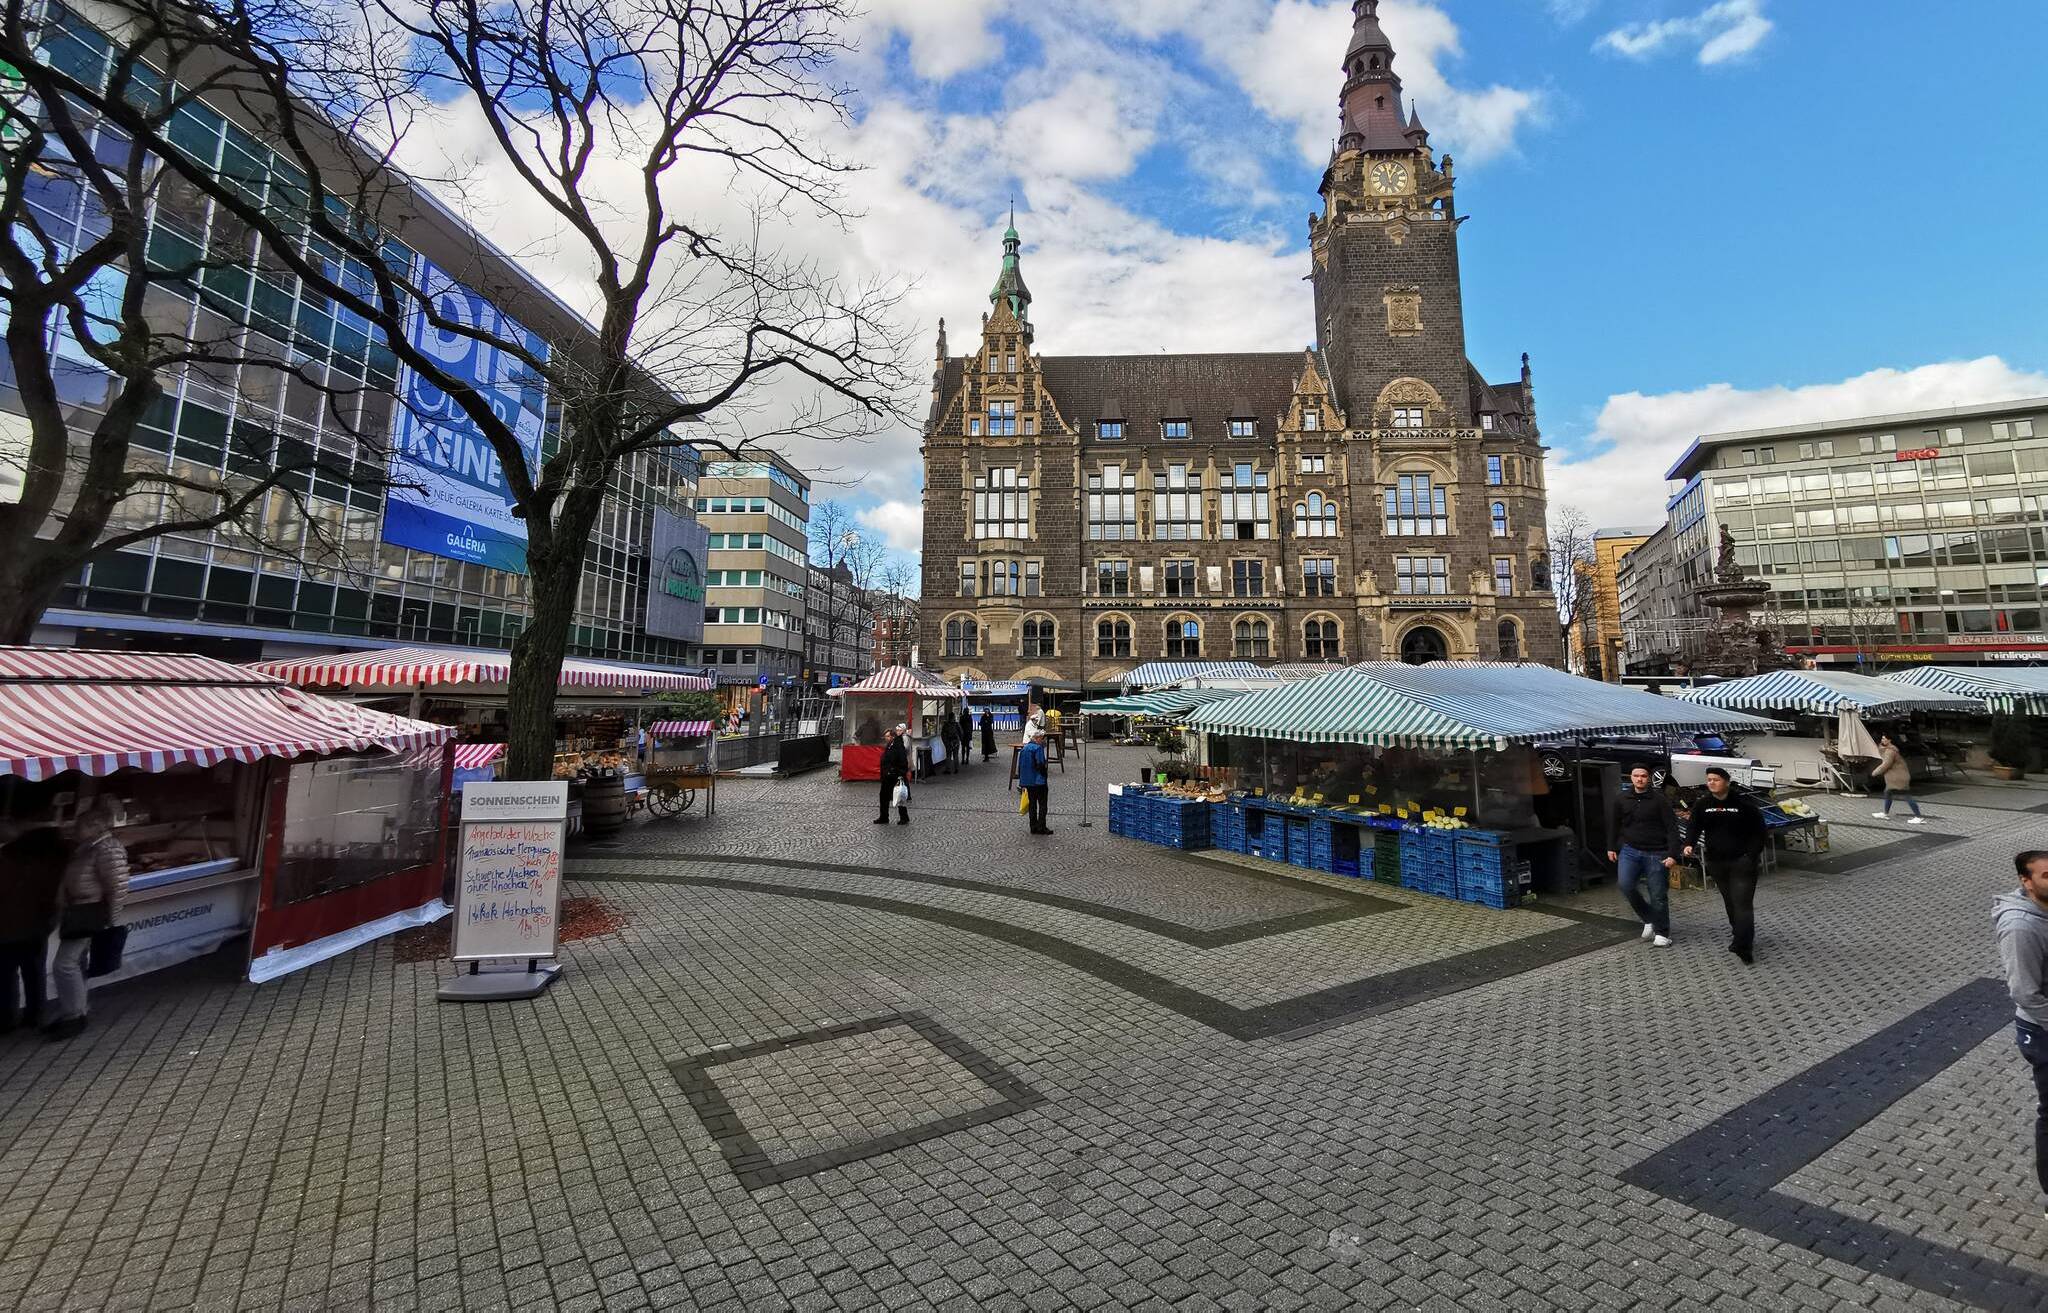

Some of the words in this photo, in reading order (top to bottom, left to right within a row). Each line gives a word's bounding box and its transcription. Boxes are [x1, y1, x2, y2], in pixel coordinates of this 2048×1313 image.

[420, 265, 527, 403] DIE
[408, 415, 501, 488] KEINE
[1896, 448, 1938, 461] ERGO
[433, 488, 455, 505] NEUE
[455, 496, 483, 514] GALERIA
[484, 506, 504, 520] KARTE
[447, 532, 487, 555] GALERIA
[469, 795, 560, 807] SONNENSCHEIN
[126, 903, 213, 933] ONNENSCHEIN
